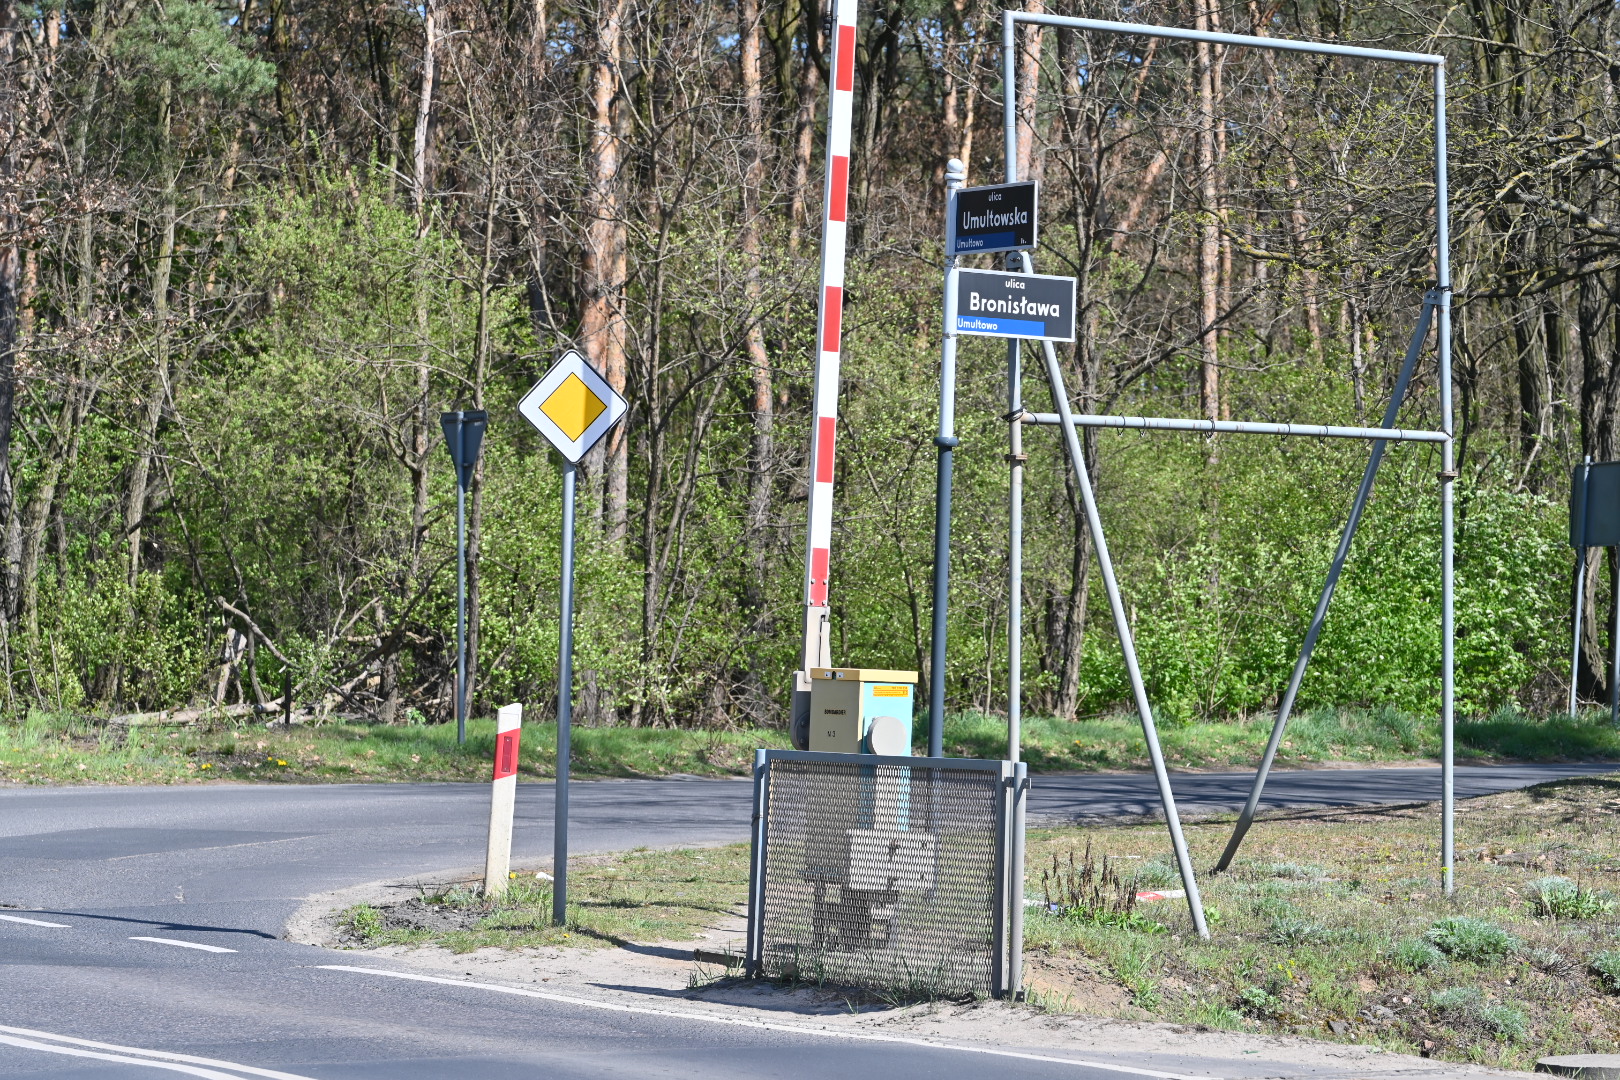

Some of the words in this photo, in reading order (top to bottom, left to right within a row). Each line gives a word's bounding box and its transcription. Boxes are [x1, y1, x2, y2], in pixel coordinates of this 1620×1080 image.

[988, 192, 1002, 202] ulica
[963, 206, 1027, 229] Umultowska
[1005, 278, 1025, 290] ulica
[970, 292, 1060, 317] Bronisława
[958, 318, 998, 330] Umultowo
